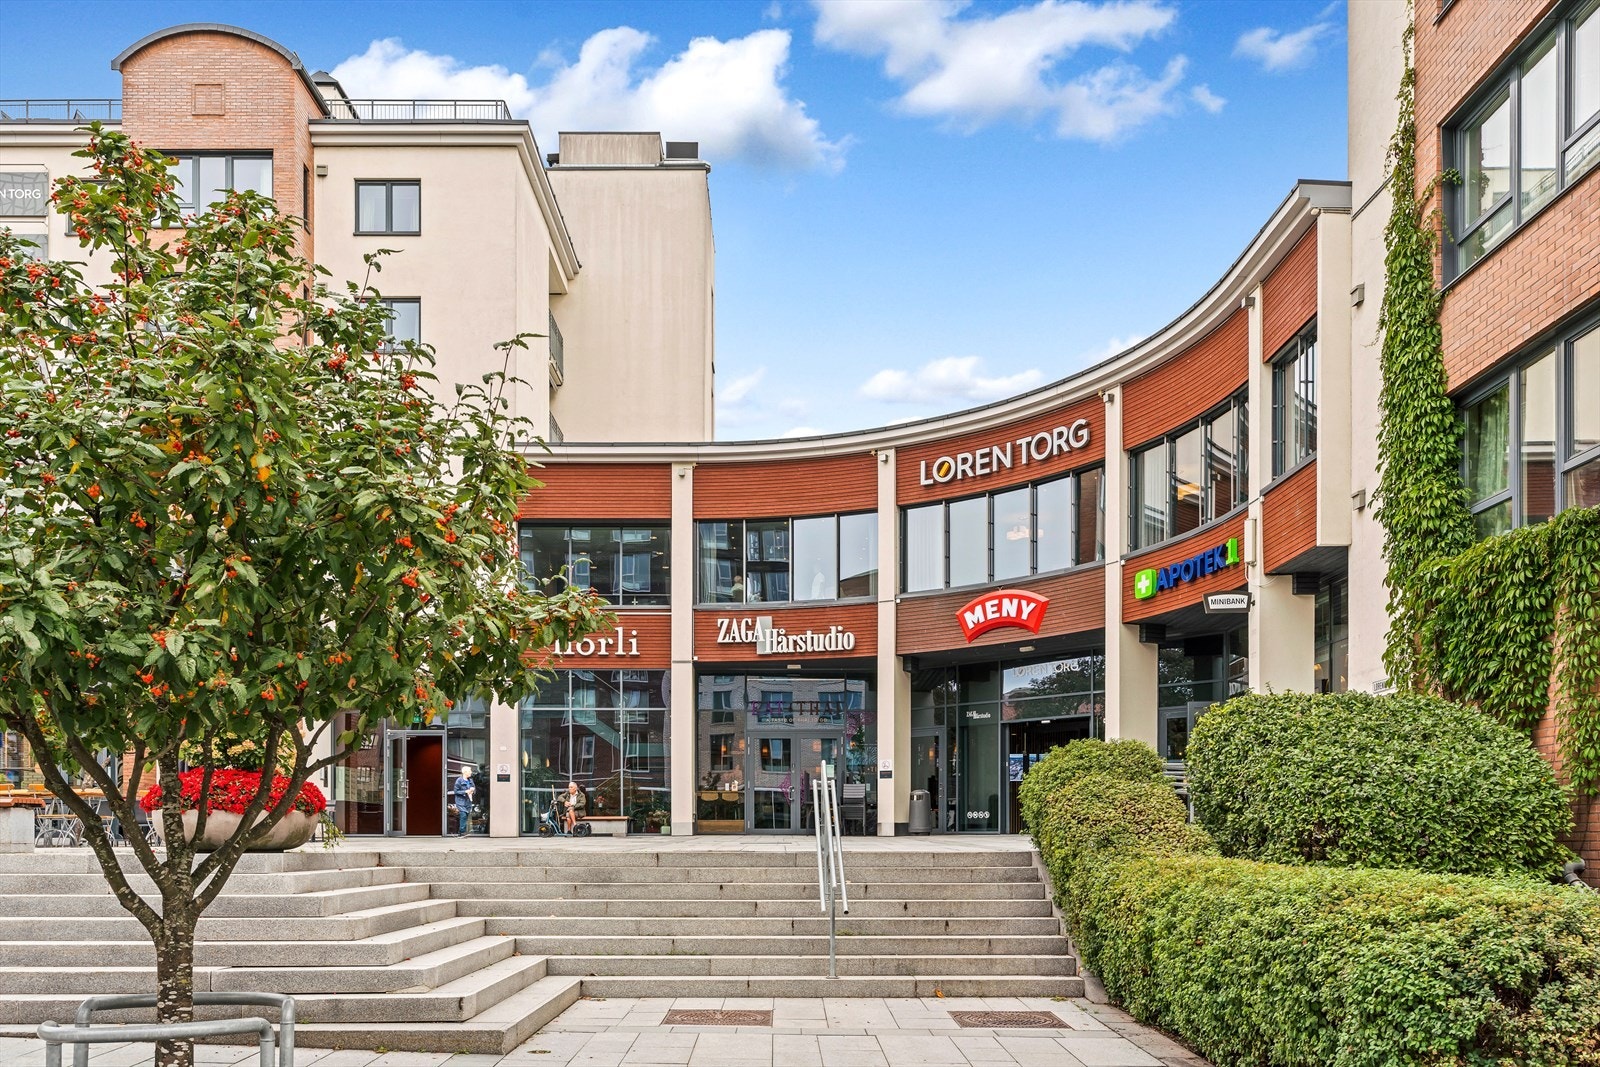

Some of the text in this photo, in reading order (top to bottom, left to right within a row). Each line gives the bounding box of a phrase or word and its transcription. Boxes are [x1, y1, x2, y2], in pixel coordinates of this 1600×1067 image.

[9, 189, 41, 199] TORG
[1016, 418, 1090, 465] TORG
[1210, 597, 1246, 606] MINIBANK
[964, 598, 1037, 630] MENY
[717, 618, 855, 653] ZAGA Hårstudio
[752, 701, 784, 715] EAT
